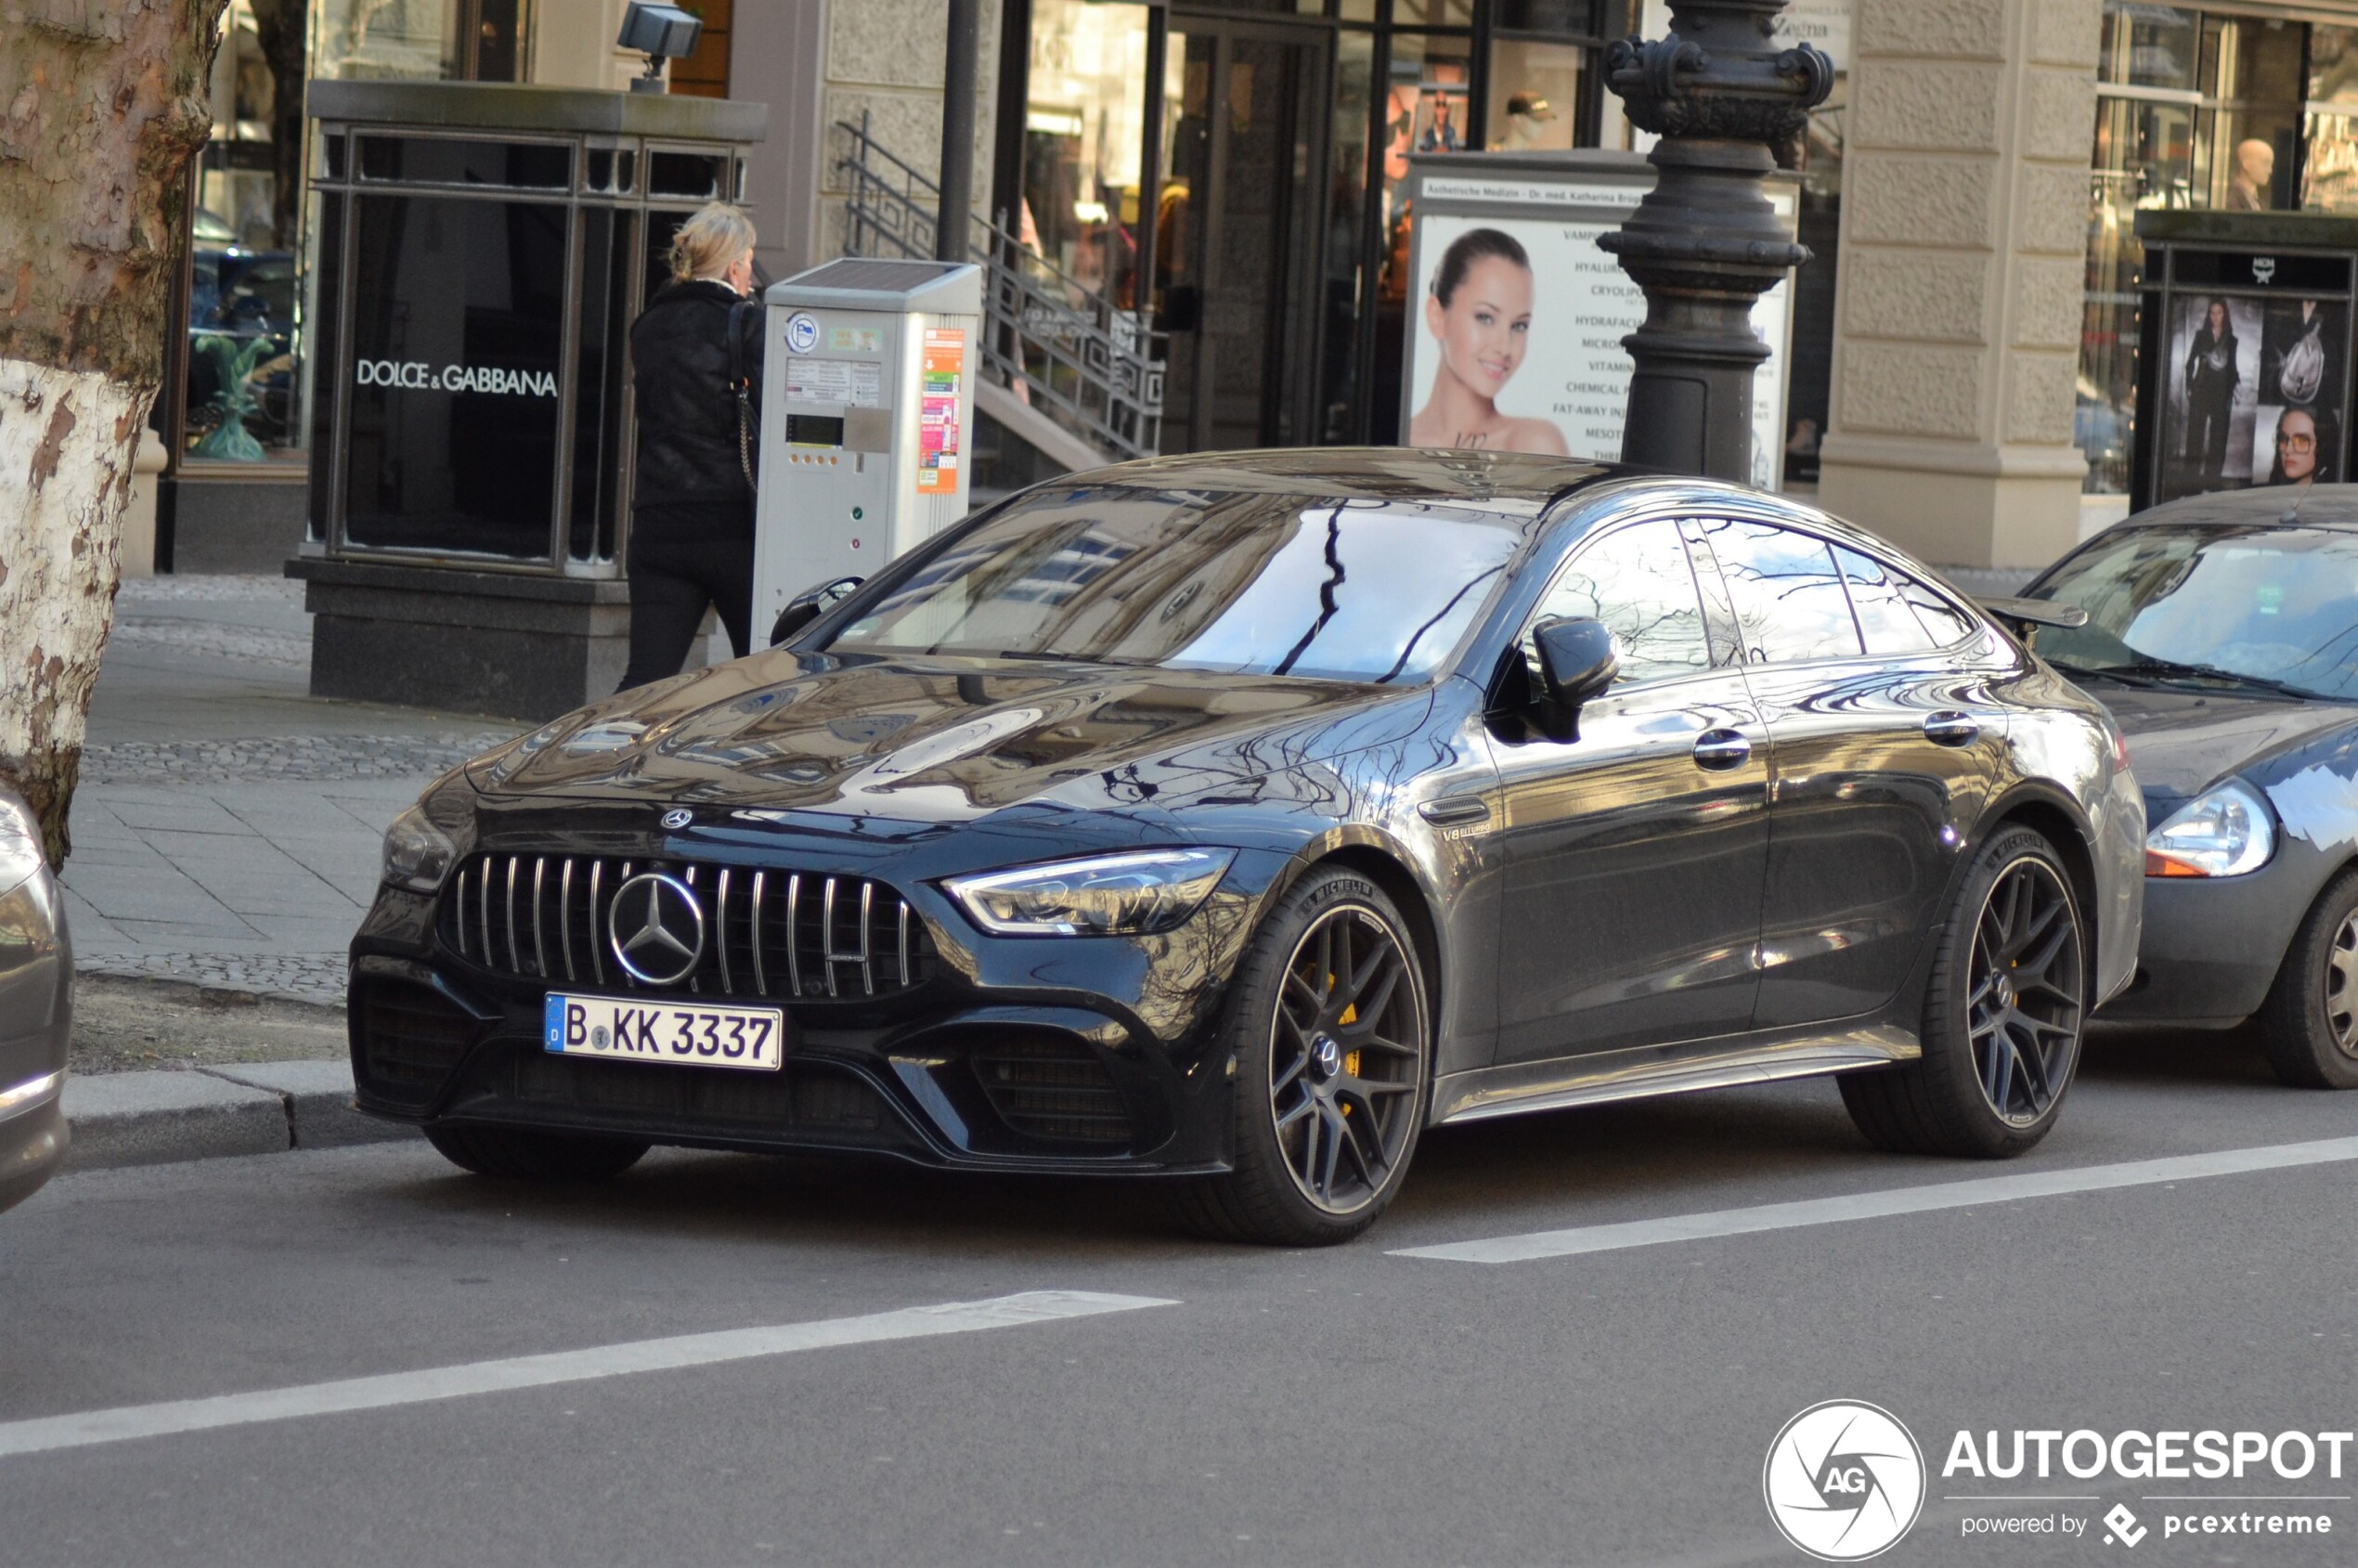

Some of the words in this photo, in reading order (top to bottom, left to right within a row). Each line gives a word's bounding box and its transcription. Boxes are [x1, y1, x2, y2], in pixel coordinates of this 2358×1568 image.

[1427, 184, 1480, 197] Ästhetische
[1483, 188, 1519, 198] Medizin
[1529, 189, 1543, 199] Dr.
[1545, 190, 1566, 201] med.
[1570, 192, 1614, 202] Katharina
[1588, 361, 1635, 372] VITAMIN
[1566, 382, 1620, 395] CHEMICAL
[1553, 403, 1606, 416] FAT-AWAY
[1443, 829, 1459, 841] V8
[1315, 880, 1371, 900] MICHELIN
[551, 1029, 559, 1042] D
[566, 1004, 587, 1045] B
[614, 1008, 661, 1053] KK
[671, 1013, 772, 1059] 3337
